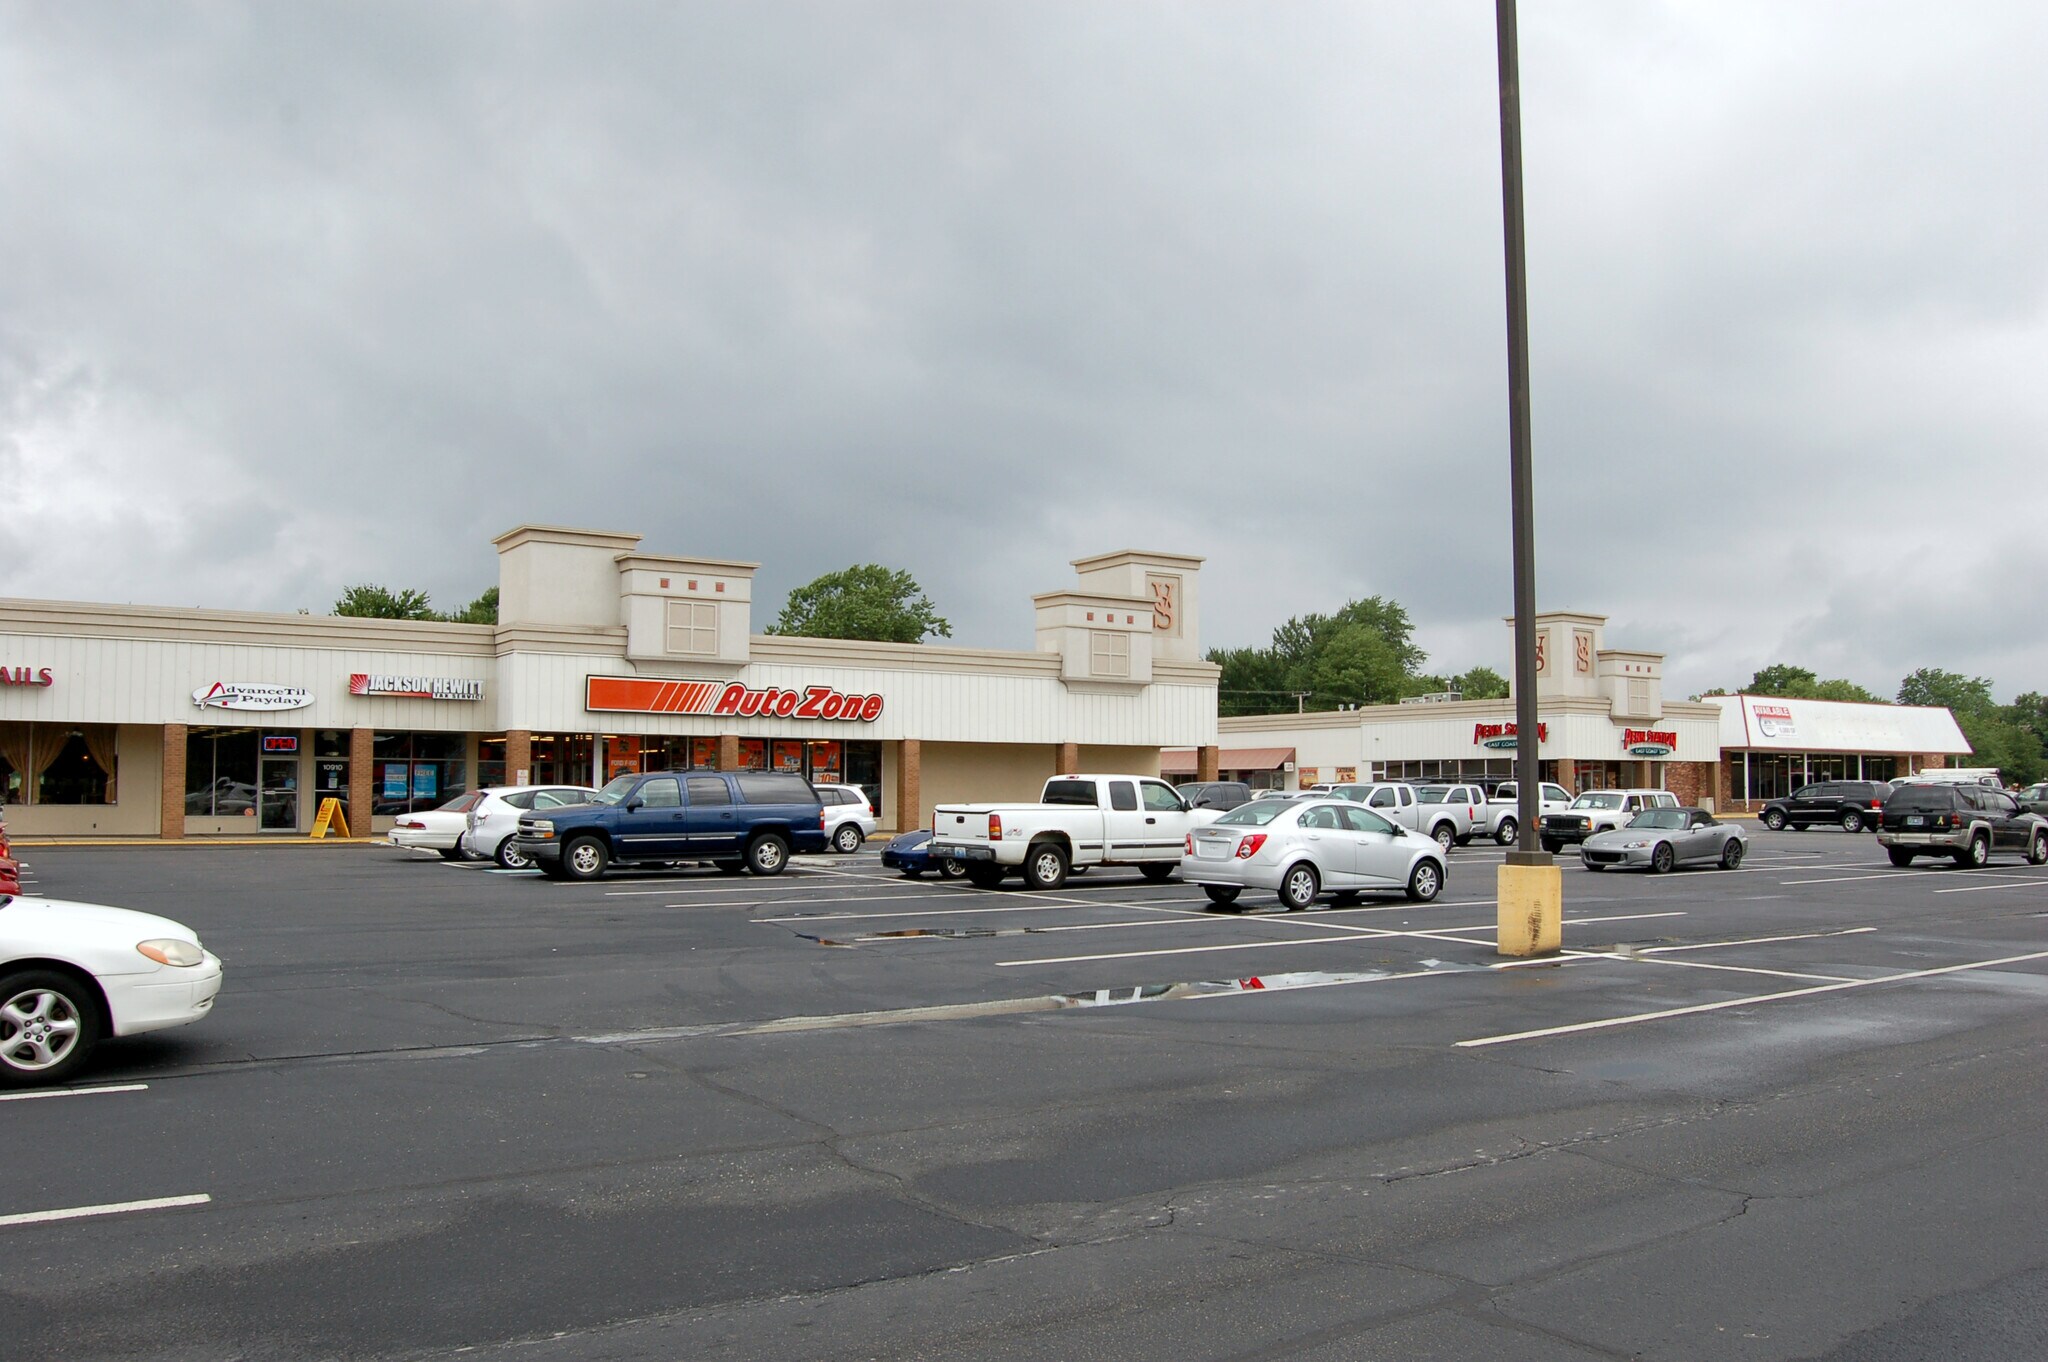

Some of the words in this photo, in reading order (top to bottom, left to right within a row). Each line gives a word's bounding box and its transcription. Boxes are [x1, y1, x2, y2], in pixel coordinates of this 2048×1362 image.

[368, 675, 431, 693] JACKSON
[432, 679, 483, 694] HEWITT
[242, 695, 302, 706] Payday
[266, 738, 296, 749] OPEN
[1624, 728, 1646, 750] PENN
[1647, 730, 1676, 751] STATION
